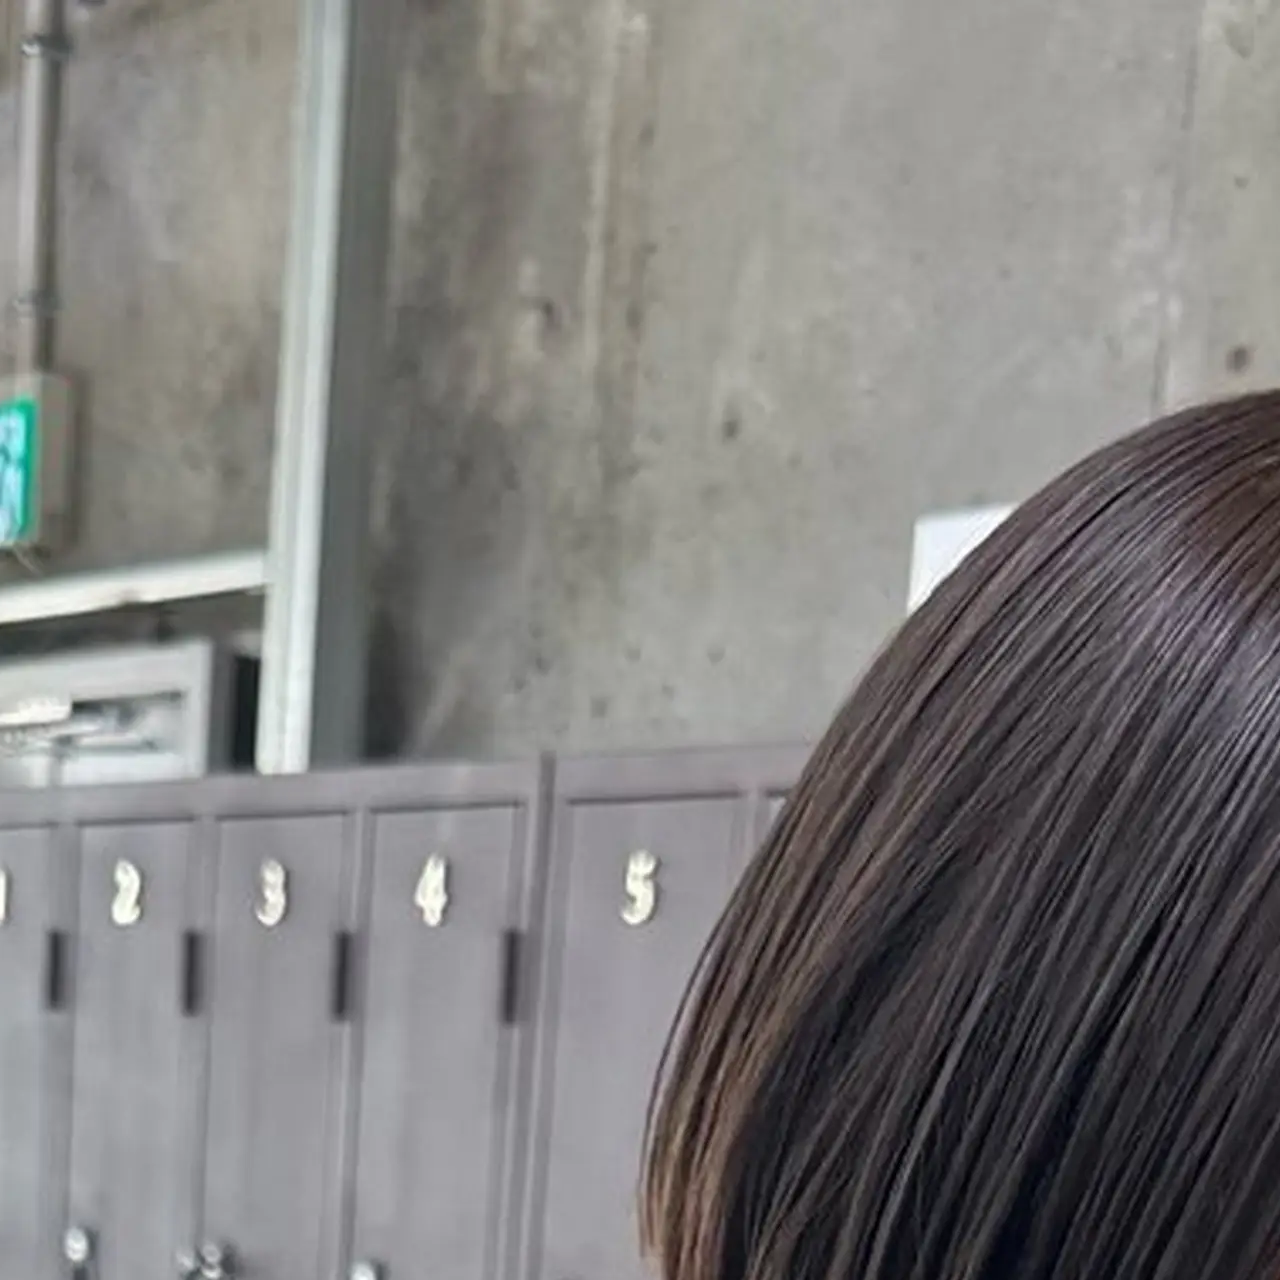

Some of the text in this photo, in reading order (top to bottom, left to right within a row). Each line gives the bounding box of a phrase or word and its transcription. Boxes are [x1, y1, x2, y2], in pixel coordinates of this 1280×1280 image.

[111, 857, 141, 926] 2
[256, 857, 287, 926] 3
[416, 851, 449, 927] 4
[623, 847, 660, 926] 5
